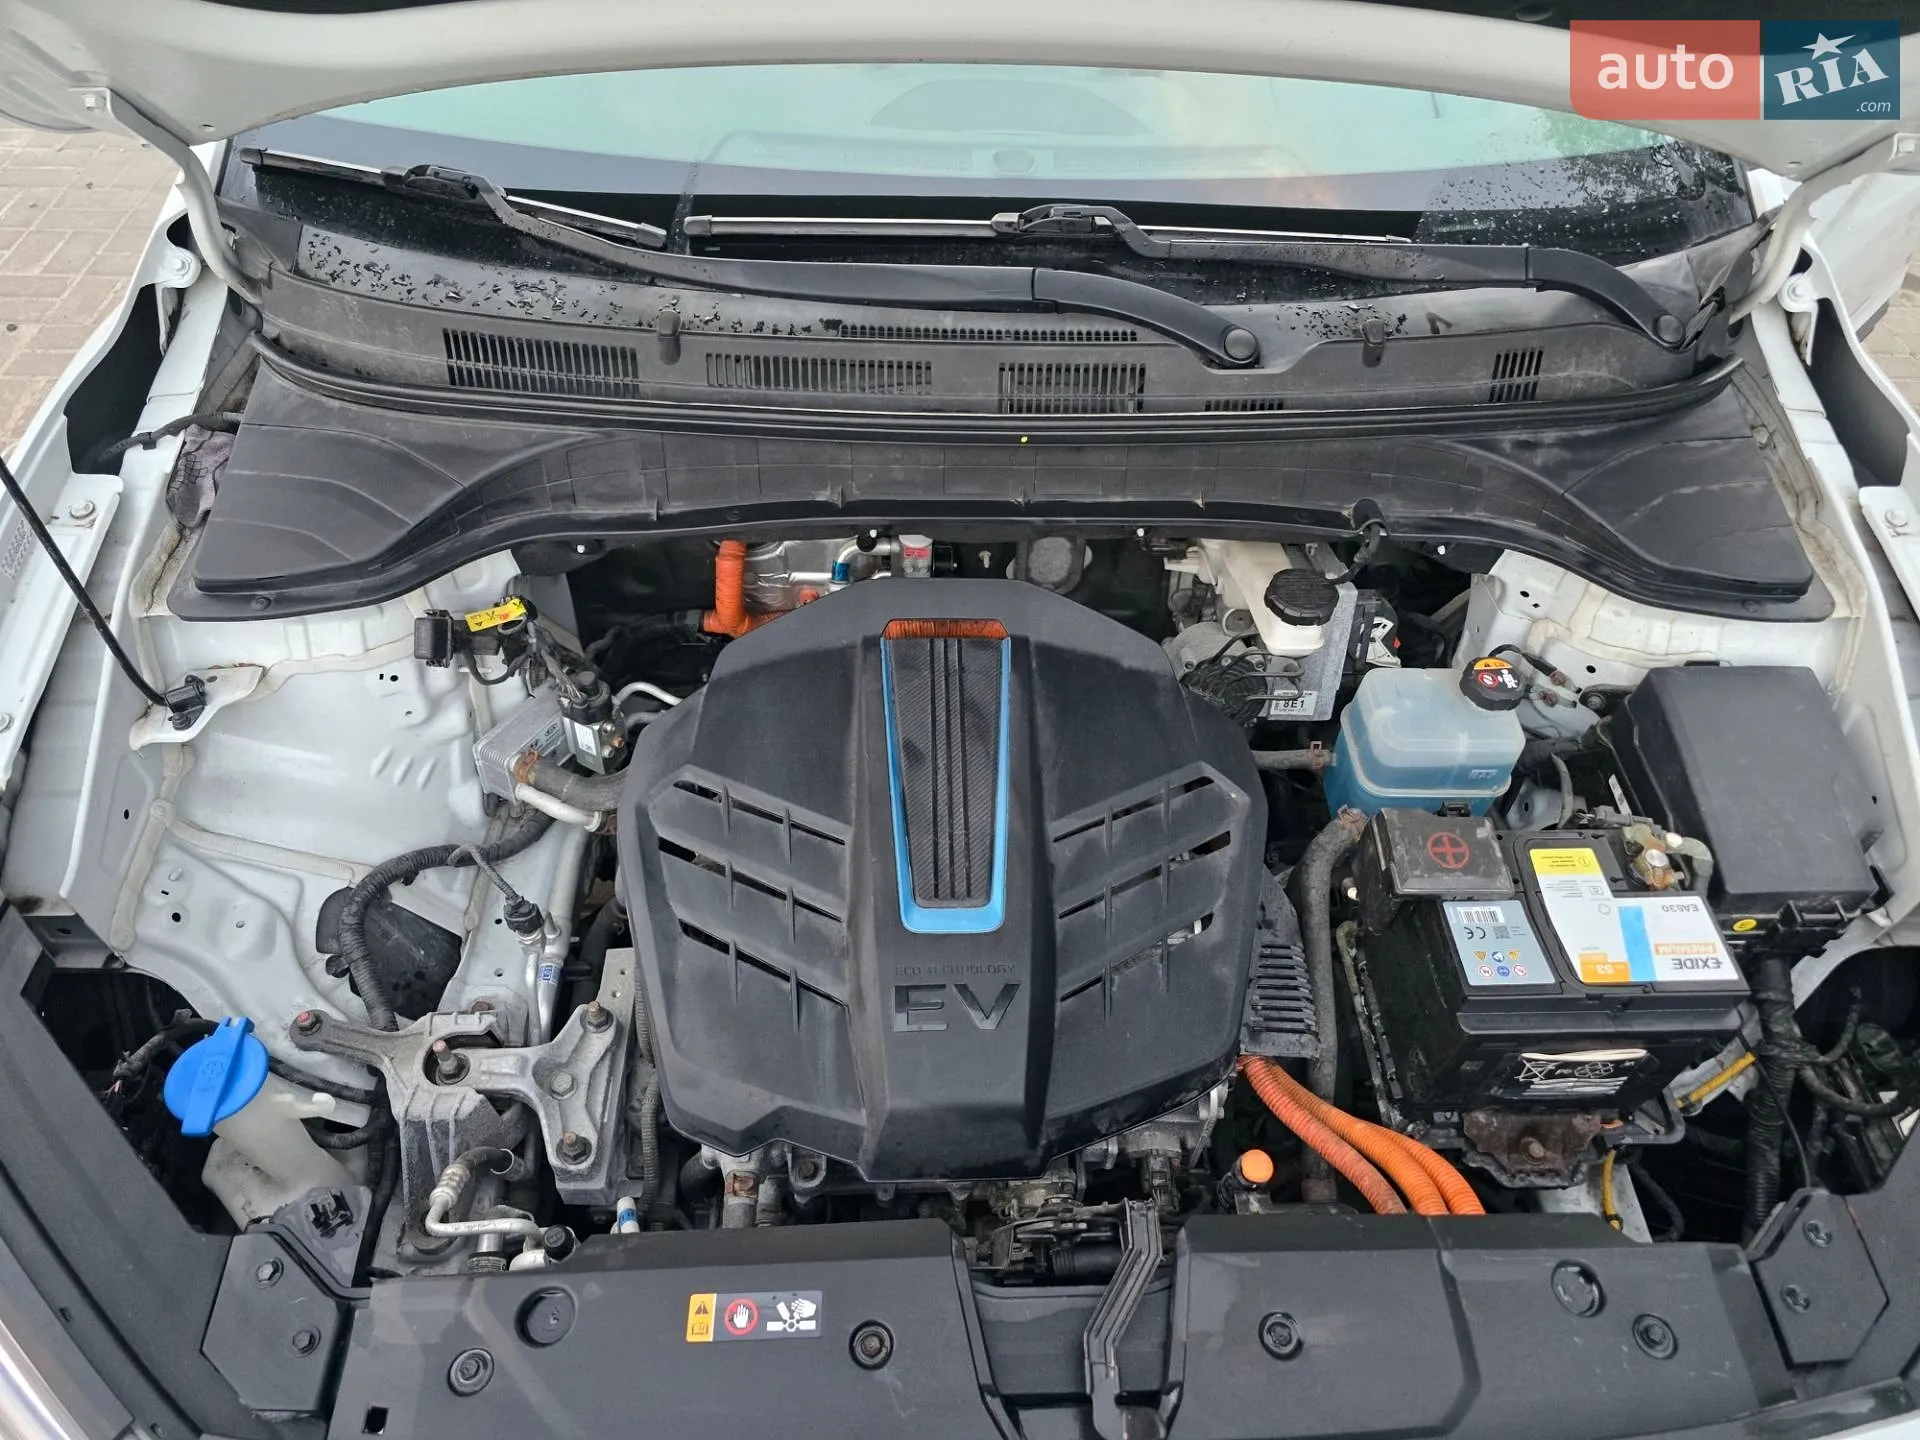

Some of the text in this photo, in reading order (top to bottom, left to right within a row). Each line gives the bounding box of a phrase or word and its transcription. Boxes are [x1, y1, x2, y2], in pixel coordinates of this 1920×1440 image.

[1661, 903, 1699, 913] EA530
[1656, 945, 1714, 955] PREMIUM
[1671, 957, 1723, 970] EXIDE
[895, 964, 921, 976] ECO
[893, 982, 1021, 1032] EV
